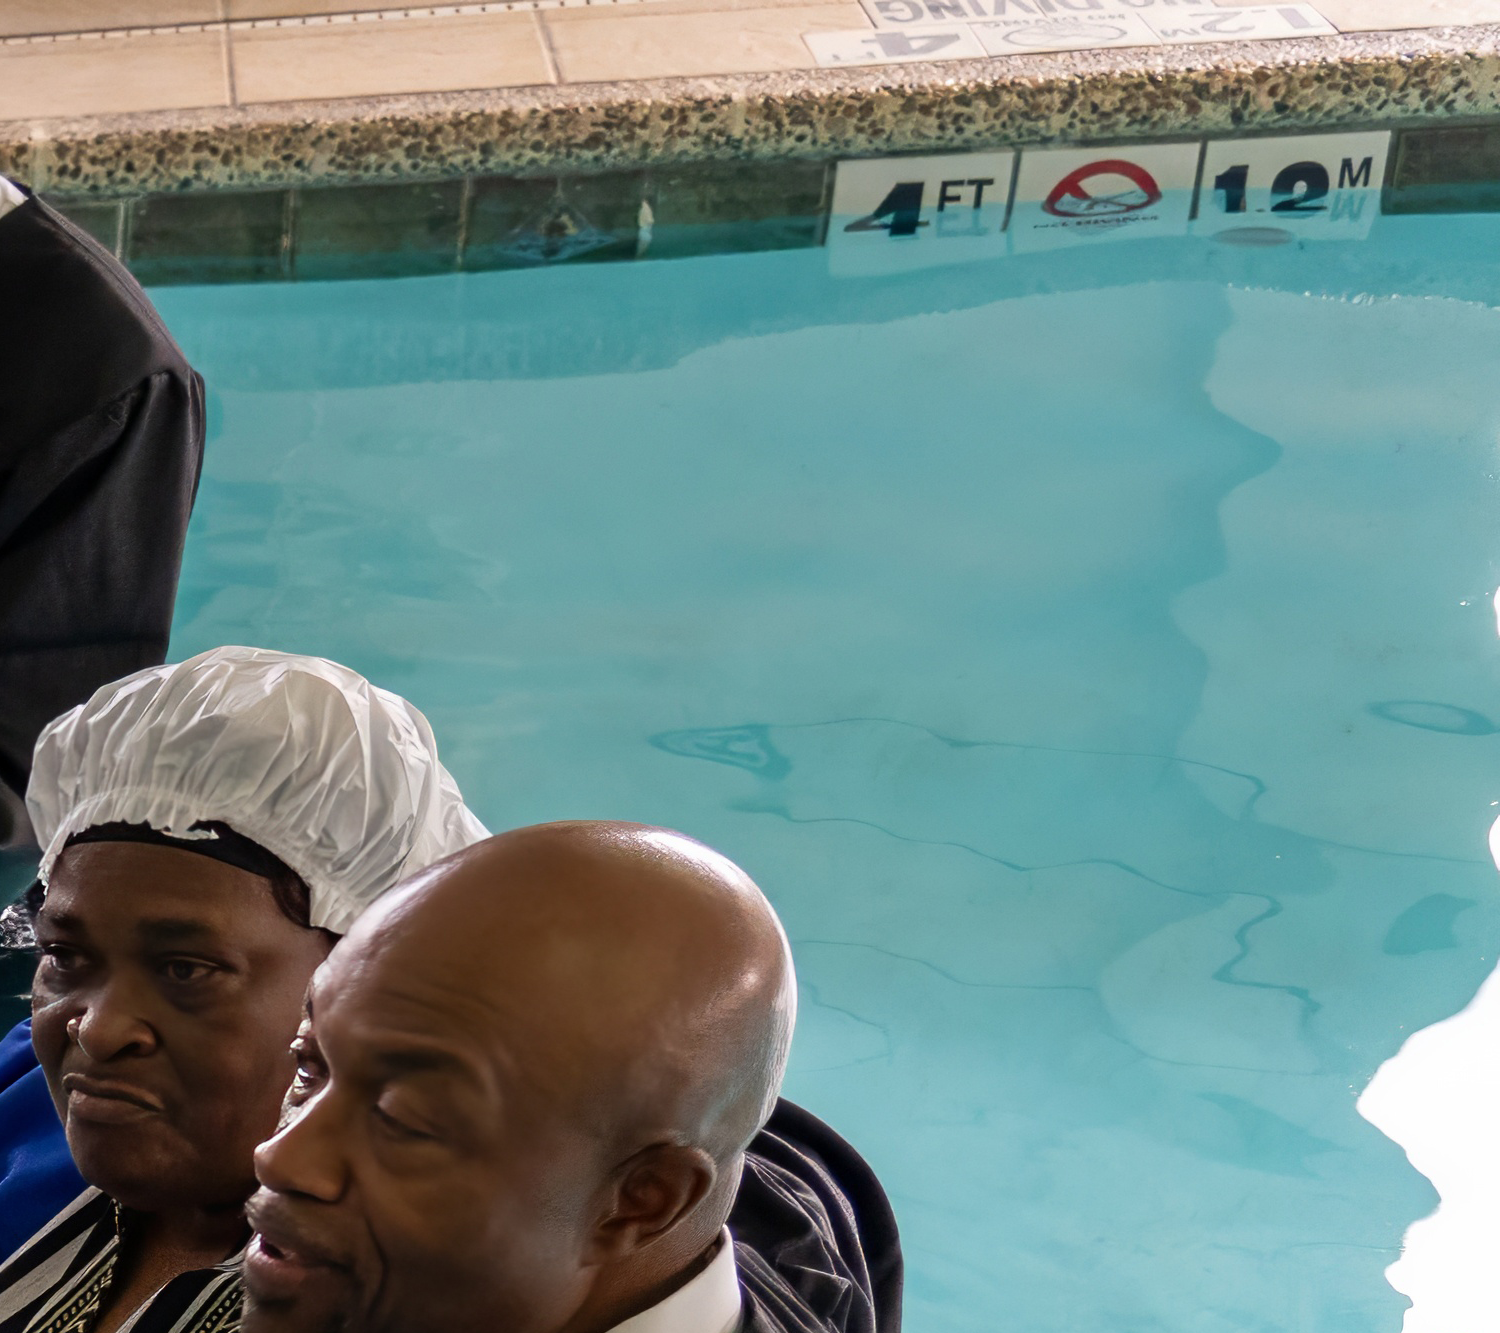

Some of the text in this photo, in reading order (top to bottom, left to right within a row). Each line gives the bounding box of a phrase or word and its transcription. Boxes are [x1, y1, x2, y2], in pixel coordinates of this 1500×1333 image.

[861, 32, 961, 57] 4
[843, 178, 994, 237] 4 FT
[1214, 157, 1373, 213] 1.2 M
